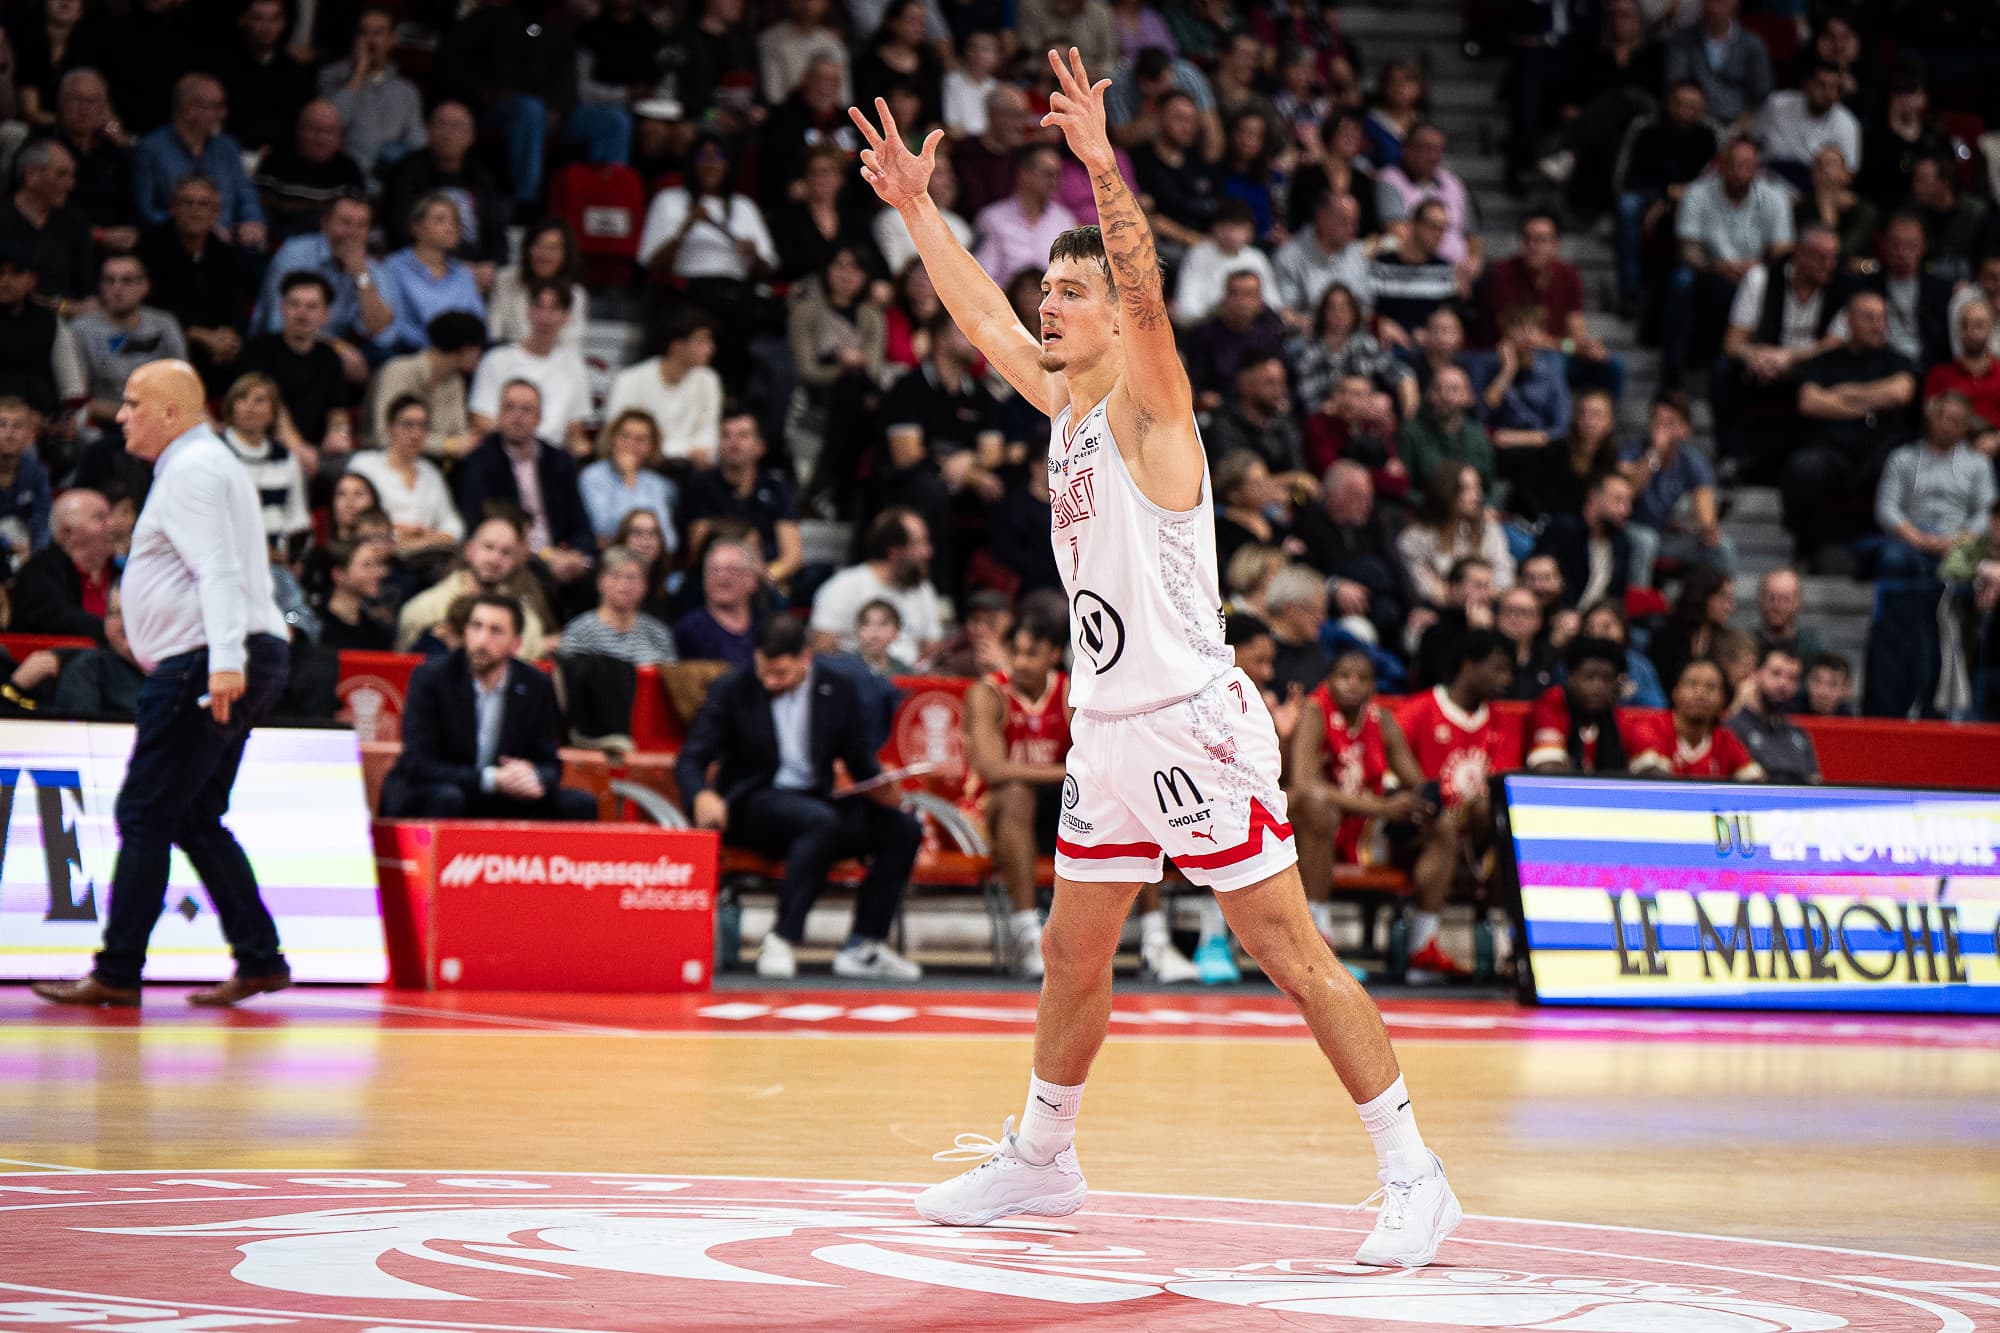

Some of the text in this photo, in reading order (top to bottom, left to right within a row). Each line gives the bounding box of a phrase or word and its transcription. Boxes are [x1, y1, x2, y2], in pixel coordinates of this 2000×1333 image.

[1228, 681, 1248, 714] 7
[1168, 808, 1212, 828] CHOLET
[483, 855, 693, 889] DMA Dupasquier
[620, 888, 709, 911] autocars
[1609, 897, 1669, 976] LE
[1695, 876, 1968, 983] MARCHÉ
